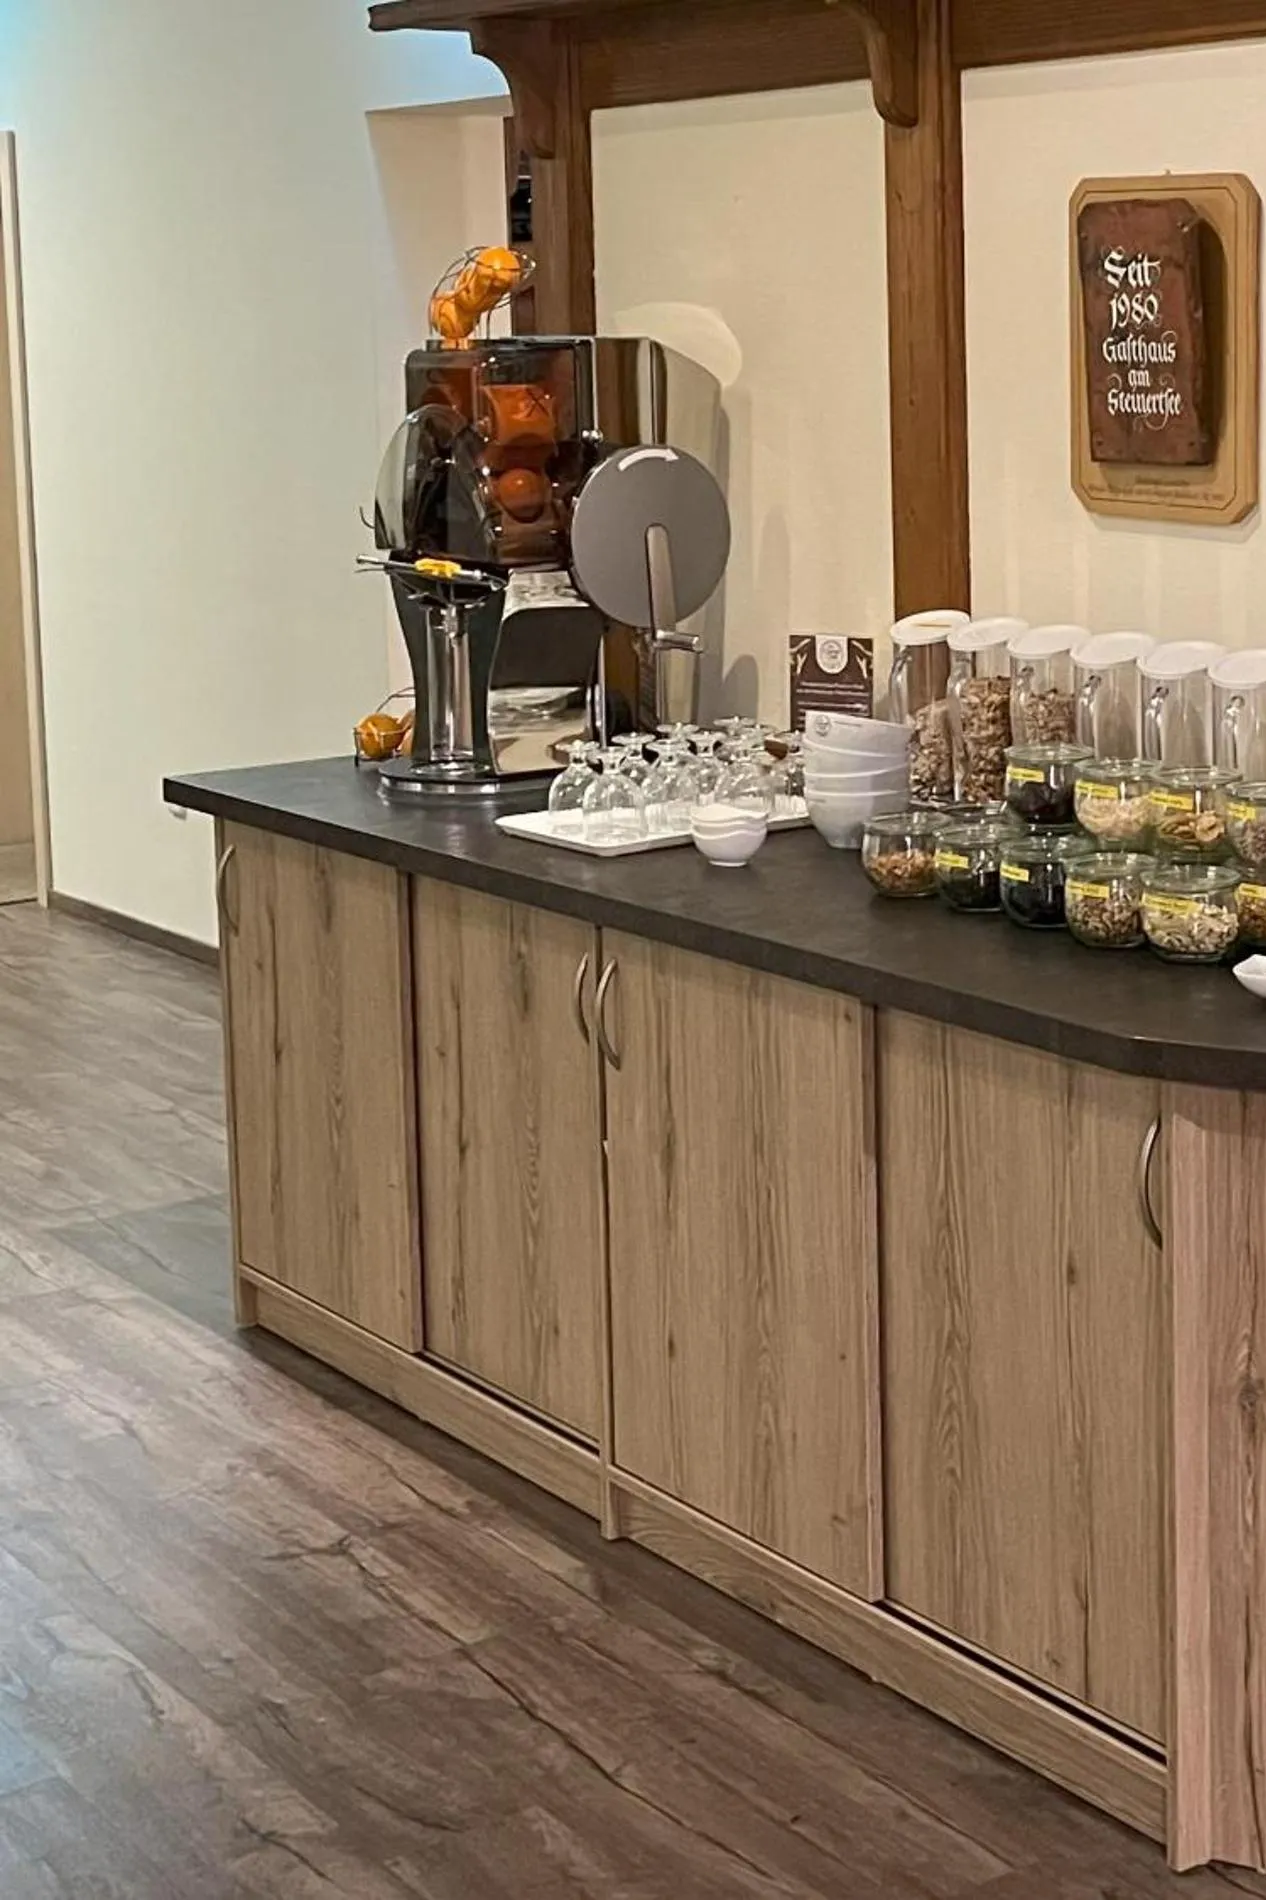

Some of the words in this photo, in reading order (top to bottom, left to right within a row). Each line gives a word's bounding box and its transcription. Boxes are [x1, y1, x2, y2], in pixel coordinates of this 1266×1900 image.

[1104, 247, 1161, 288] Seit
[1110, 293, 1160, 330] 1980
[1128, 369, 1151, 390] am
